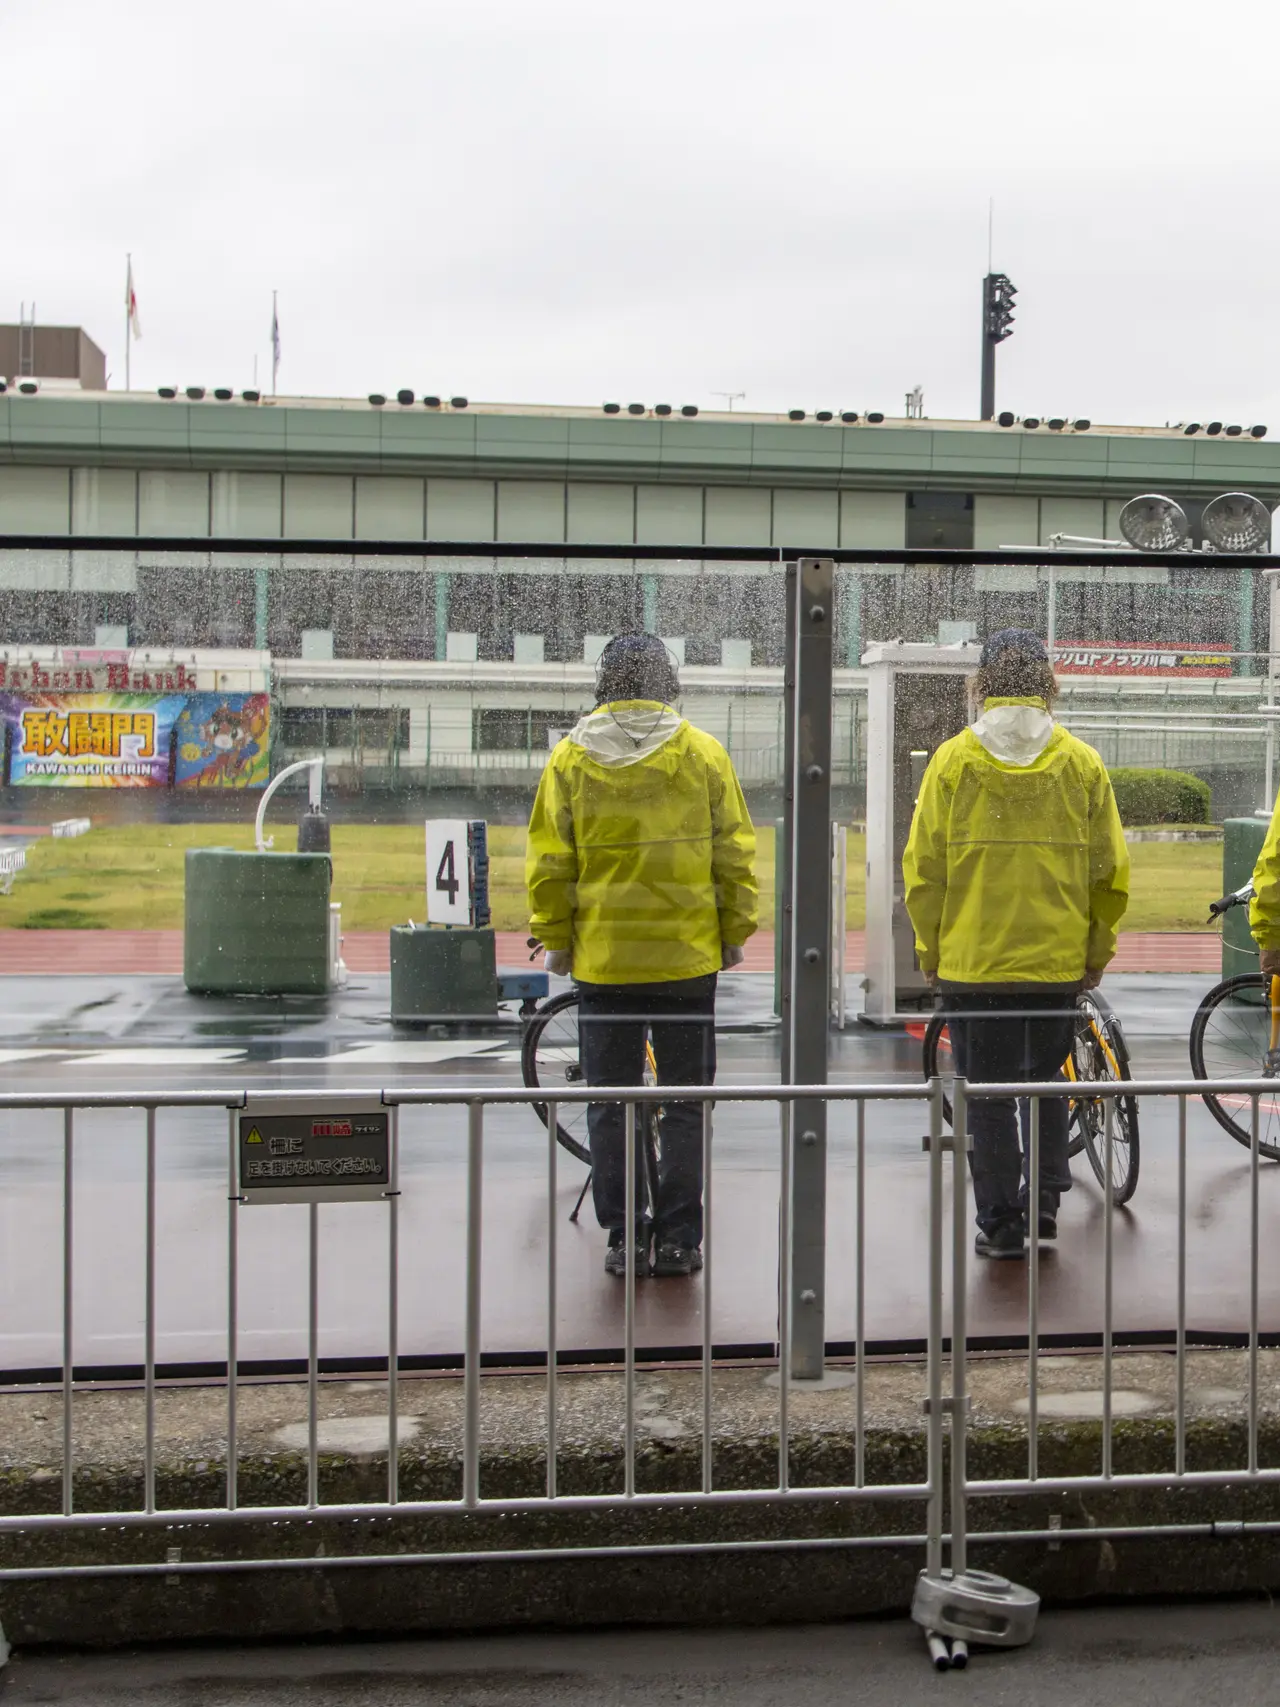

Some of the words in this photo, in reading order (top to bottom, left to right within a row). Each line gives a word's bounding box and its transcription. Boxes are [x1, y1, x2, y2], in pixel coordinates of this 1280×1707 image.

[22, 710, 155, 757] 敢闘門
[26, 763, 100, 775] KAWASAKI
[104, 763, 151, 775] KEIRIN
[436, 840, 459, 905] 4
[269, 1137, 303, 1155] 柵に
[247, 1157, 382, 1178] 足を掛けないでください。
